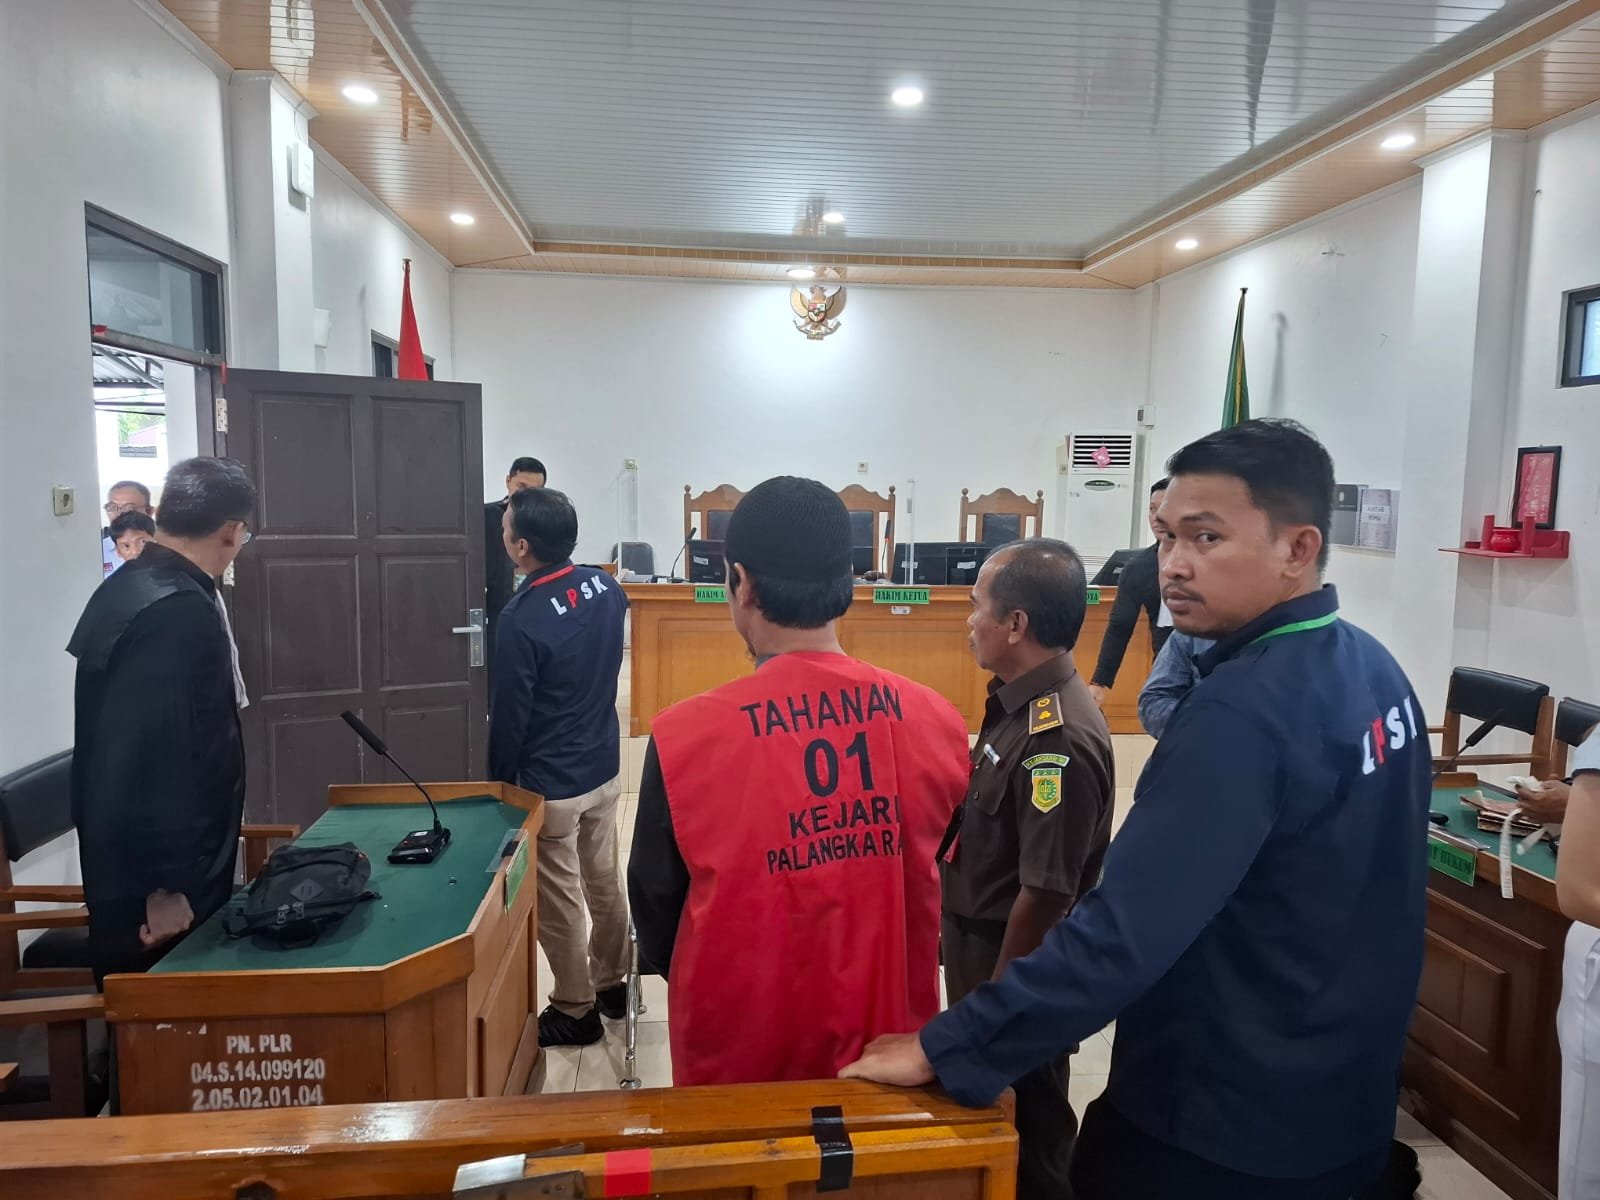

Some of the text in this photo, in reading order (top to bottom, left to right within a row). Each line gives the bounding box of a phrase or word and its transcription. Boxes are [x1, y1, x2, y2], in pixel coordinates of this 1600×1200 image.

[550, 575, 609, 615] LPSK
[875, 591, 928, 601] HAKIM KETUA
[739, 683, 903, 737] TAHANAN
[804, 731, 875, 798] 01
[788, 795, 901, 840] KEJARI
[226, 1033, 293, 1055] PN. PLR
[190, 1057, 326, 1084] 04.S.14.099120
[191, 1083, 324, 1112] 2.05.02.01.04
